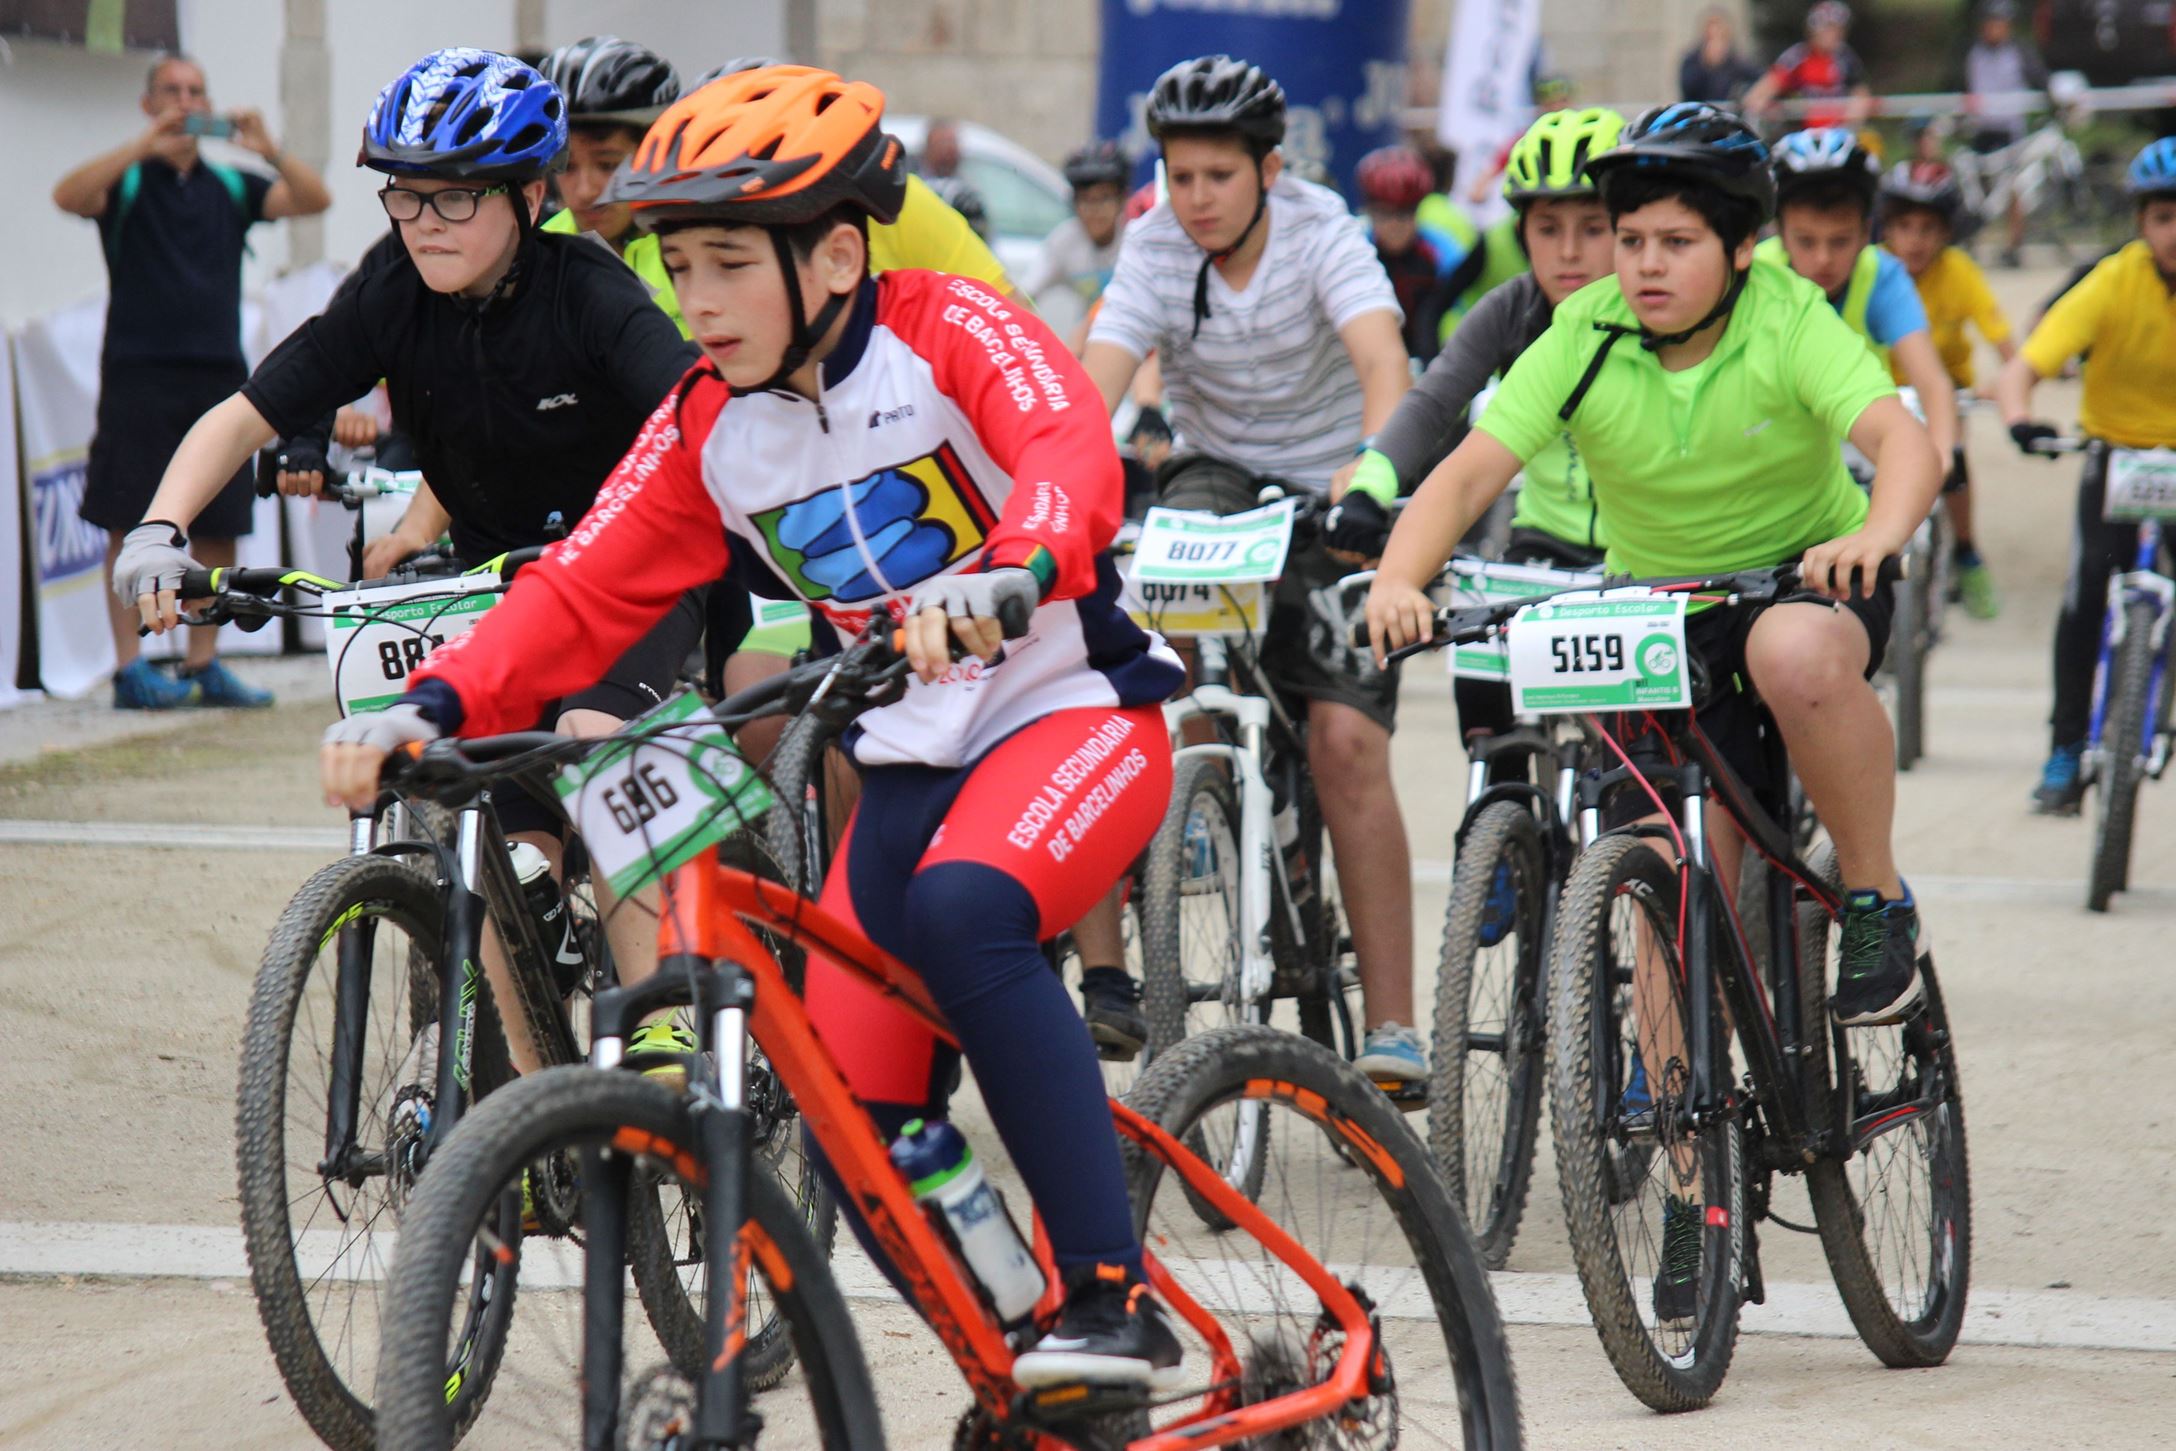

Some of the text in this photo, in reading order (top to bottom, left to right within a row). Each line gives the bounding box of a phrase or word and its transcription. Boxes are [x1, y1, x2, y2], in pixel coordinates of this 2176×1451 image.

[1168, 541, 1240, 560] 8077
[1560, 603, 1660, 618] Desporto Escolar
[1552, 635, 1624, 673] 5159
[1007, 714, 1135, 849] ESCOLA SECUNDÁRIA
[1047, 748, 1147, 863] DE BARCELINHOS
